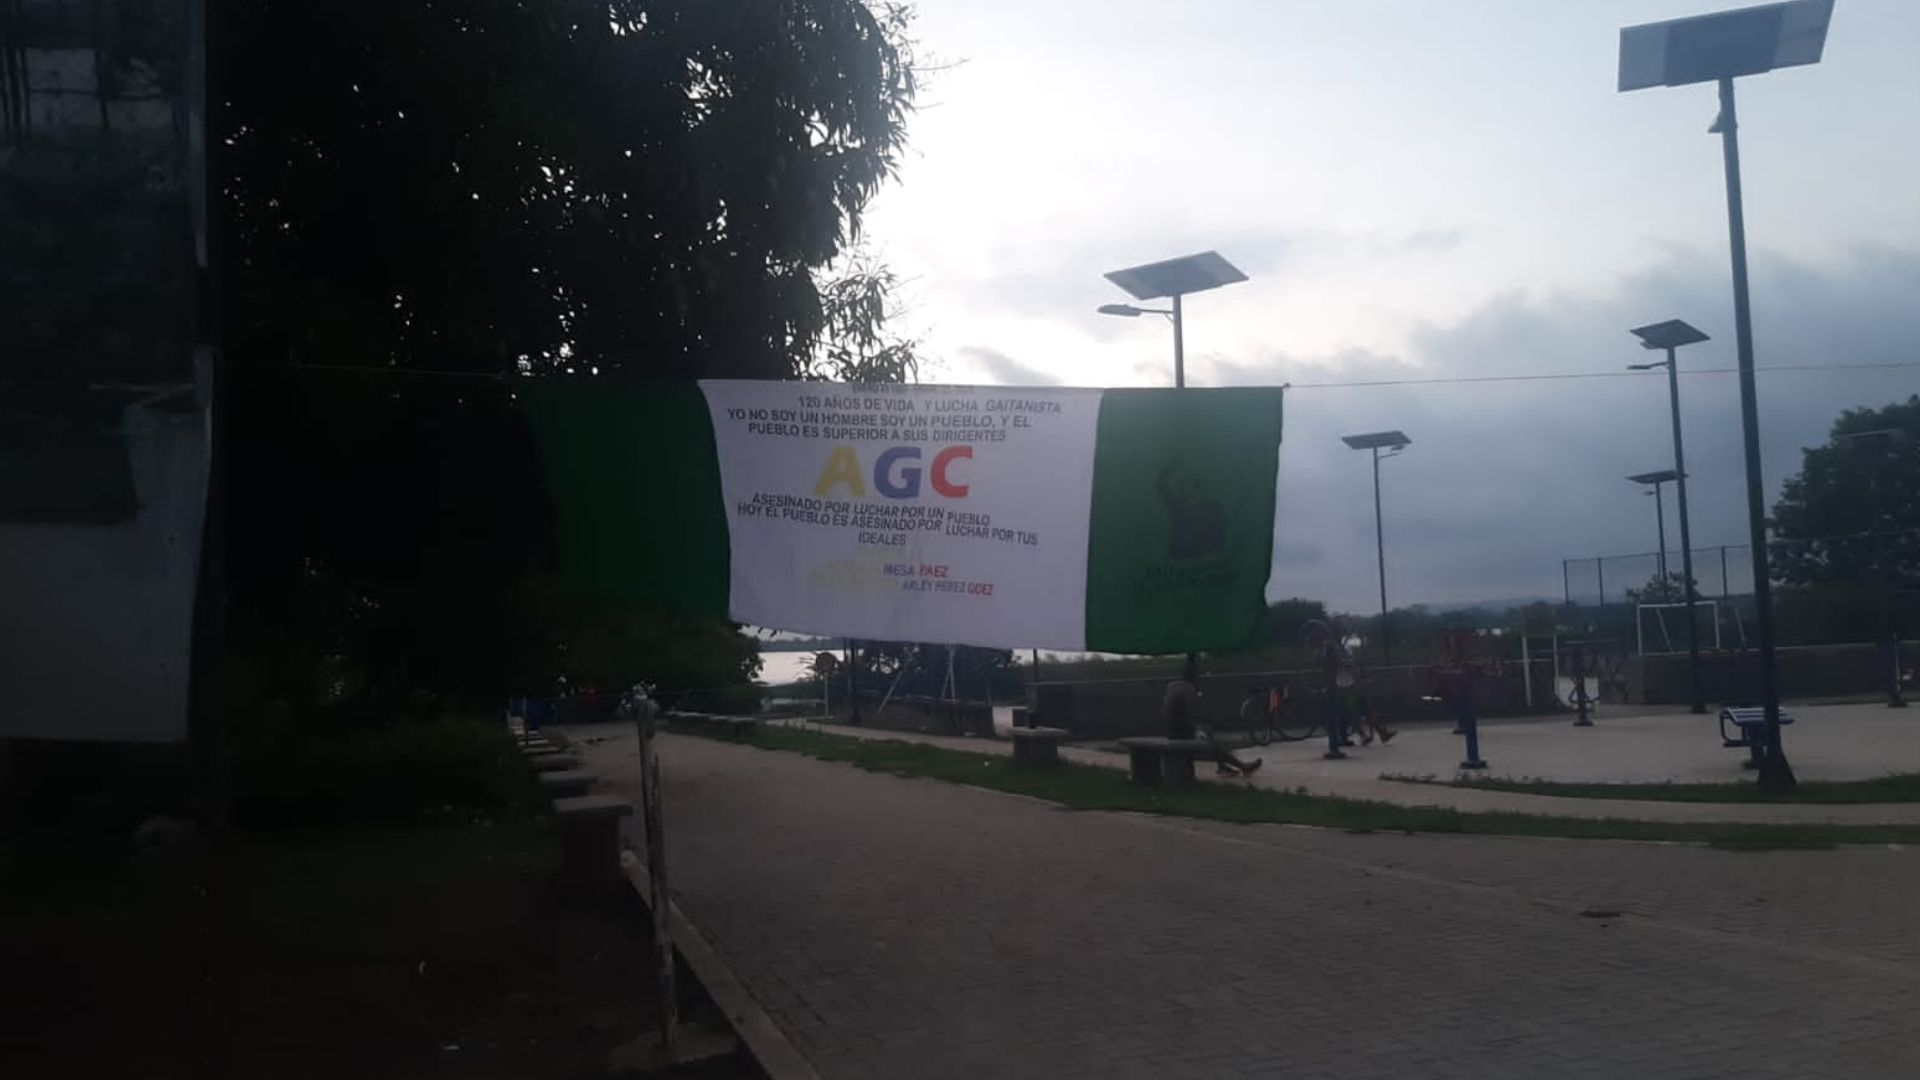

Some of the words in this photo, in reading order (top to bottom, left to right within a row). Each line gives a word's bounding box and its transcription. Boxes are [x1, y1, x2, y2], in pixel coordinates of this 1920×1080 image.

[798, 396, 821, 409] 120
[864, 398, 883, 411] DE
[884, 398, 914, 412] VIDA
[923, 398, 933, 412] Y
[934, 399, 978, 412] LUCHA
[985, 399, 1061, 414] GAITANISTA
[727, 408, 747, 420] YO
[748, 409, 769, 421] NO
[770, 410, 797, 423] SOY
[801, 412, 819, 424] UN
[822, 413, 878, 426] HOMBRE
[880, 414, 907, 427] SOY
[909, 414, 928, 427] UN
[1000, 415, 1009, 428] Y
[1012, 415, 1031, 428] EL
[748, 422, 799, 436] PUEBLO
[801, 424, 820, 438] ES
[823, 426, 888, 440] SUPERIOR
[891, 429, 902, 440] A
[904, 429, 929, 441] SUS
[933, 429, 1007, 442] DIRIGENTES
[815, 446, 973, 498] AGC
[752, 492, 822, 511] ASESINADO
[824, 501, 851, 514] POR
[852, 502, 899, 517] LUCHAR
[900, 505, 926, 518] POR
[927, 508, 945, 519] UN
[947, 511, 991, 525] PUEBLO
[737, 503, 764, 517] HOY
[765, 506, 781, 518] EL
[782, 507, 831, 526] PUEBLO
[832, 513, 849, 527] ES
[850, 515, 915, 530] ASESINADO
[917, 518, 942, 531] POR
[945, 524, 990, 538] LUCHAR
[991, 527, 1015, 542] POR
[1016, 531, 1039, 545] TUS
[858, 533, 906, 546] IDEALES
[883, 563, 915, 577] MESA
